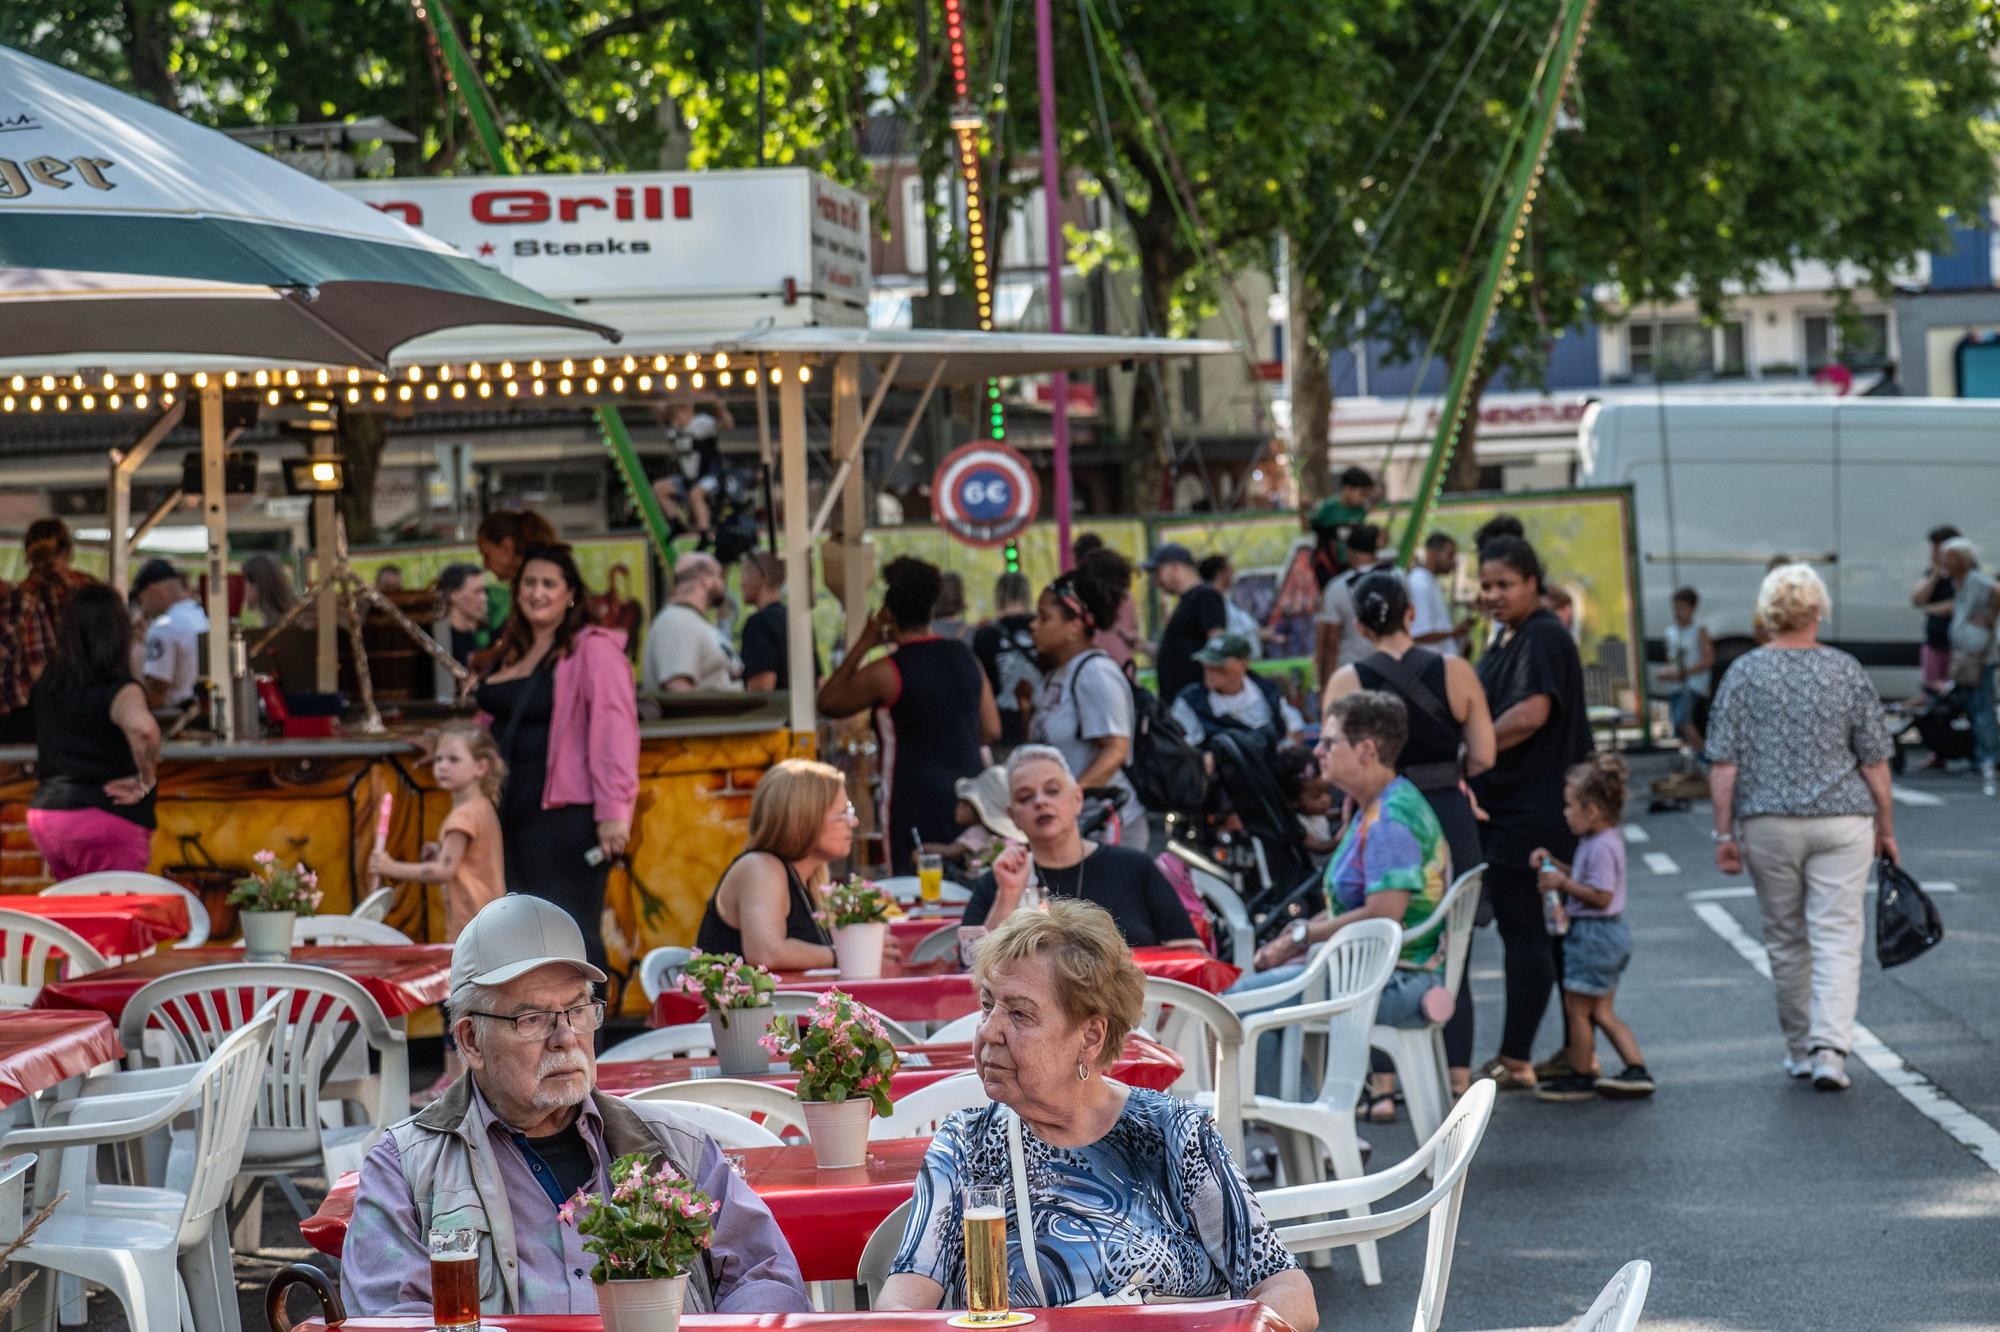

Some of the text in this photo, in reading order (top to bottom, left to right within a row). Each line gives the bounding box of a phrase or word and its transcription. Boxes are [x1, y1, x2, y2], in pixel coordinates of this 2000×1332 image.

[470, 186, 693, 225] Grill
[513, 238, 651, 257] Steaks
[963, 480, 1009, 505] 6€
